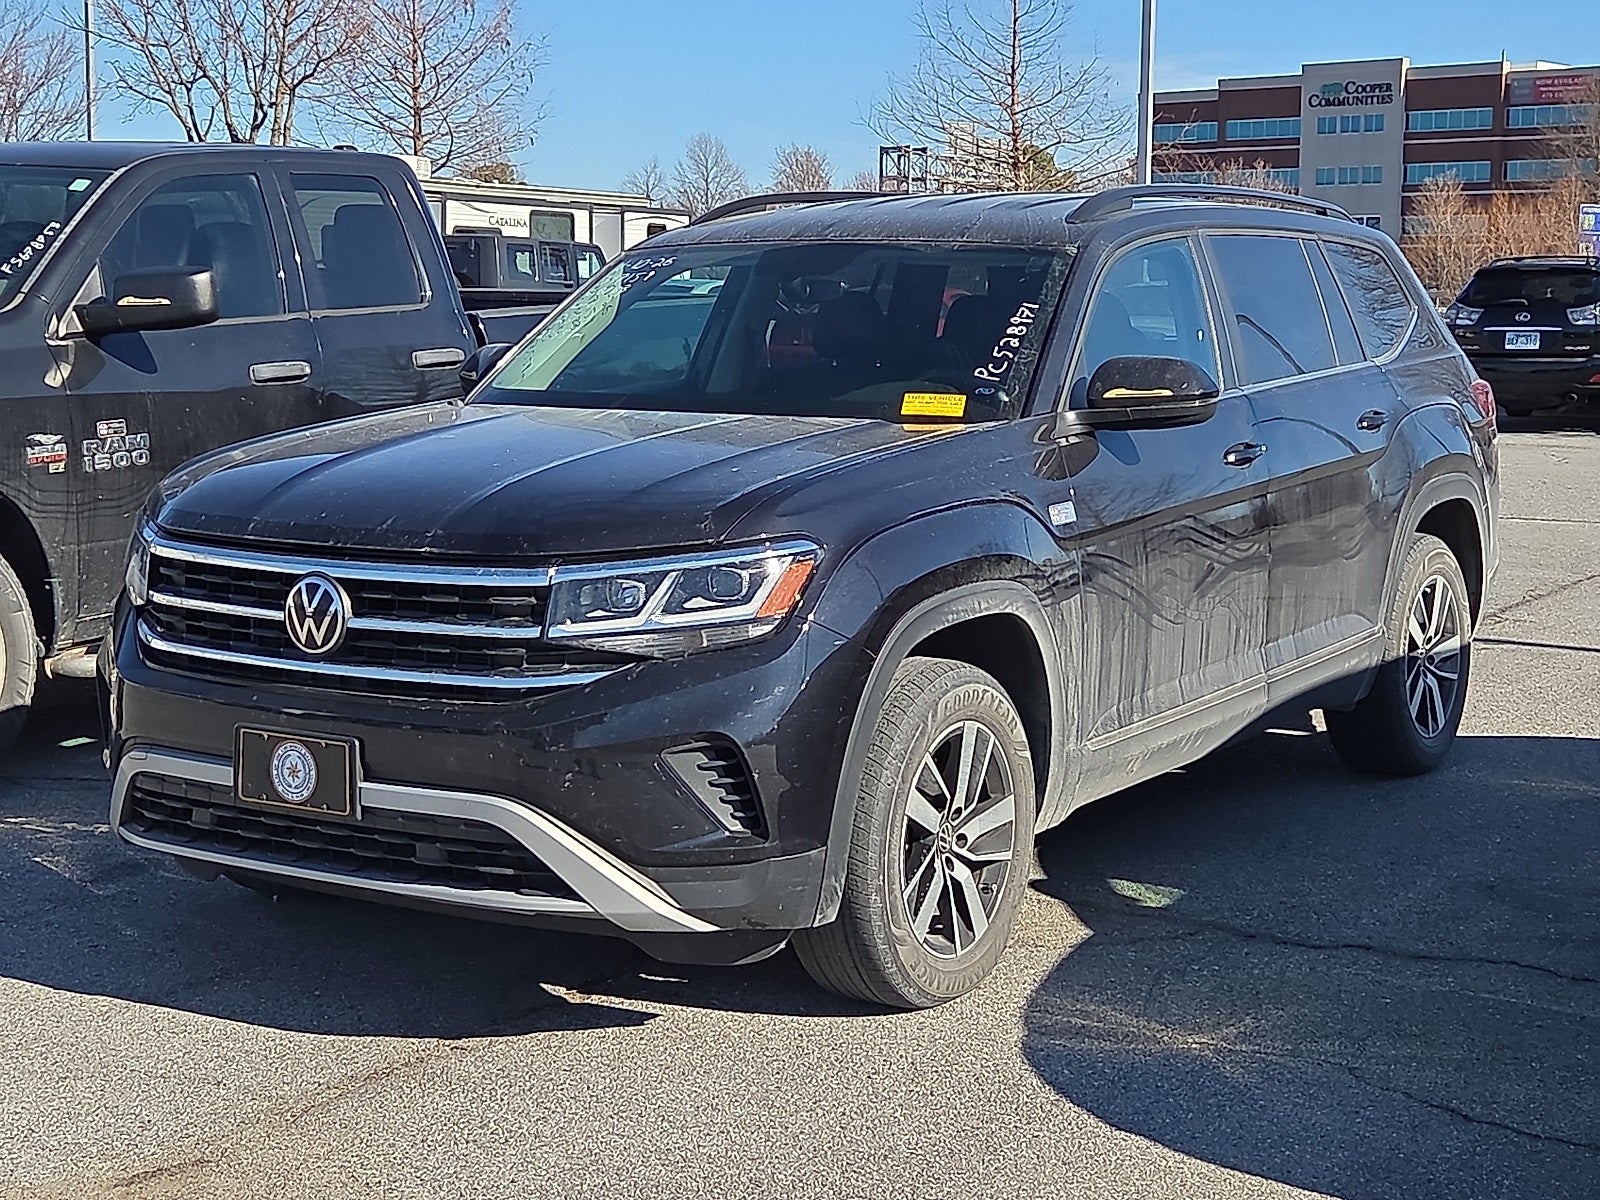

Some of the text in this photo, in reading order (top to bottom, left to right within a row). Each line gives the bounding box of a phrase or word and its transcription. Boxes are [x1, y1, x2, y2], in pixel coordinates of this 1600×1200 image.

[1344, 80, 1393, 95] COOPER
[1308, 93, 1394, 108] COMMUNITIES
[489, 215, 528, 229] CATALINA
[82, 432, 150, 456] RAM
[83, 449, 150, 473] 1500
